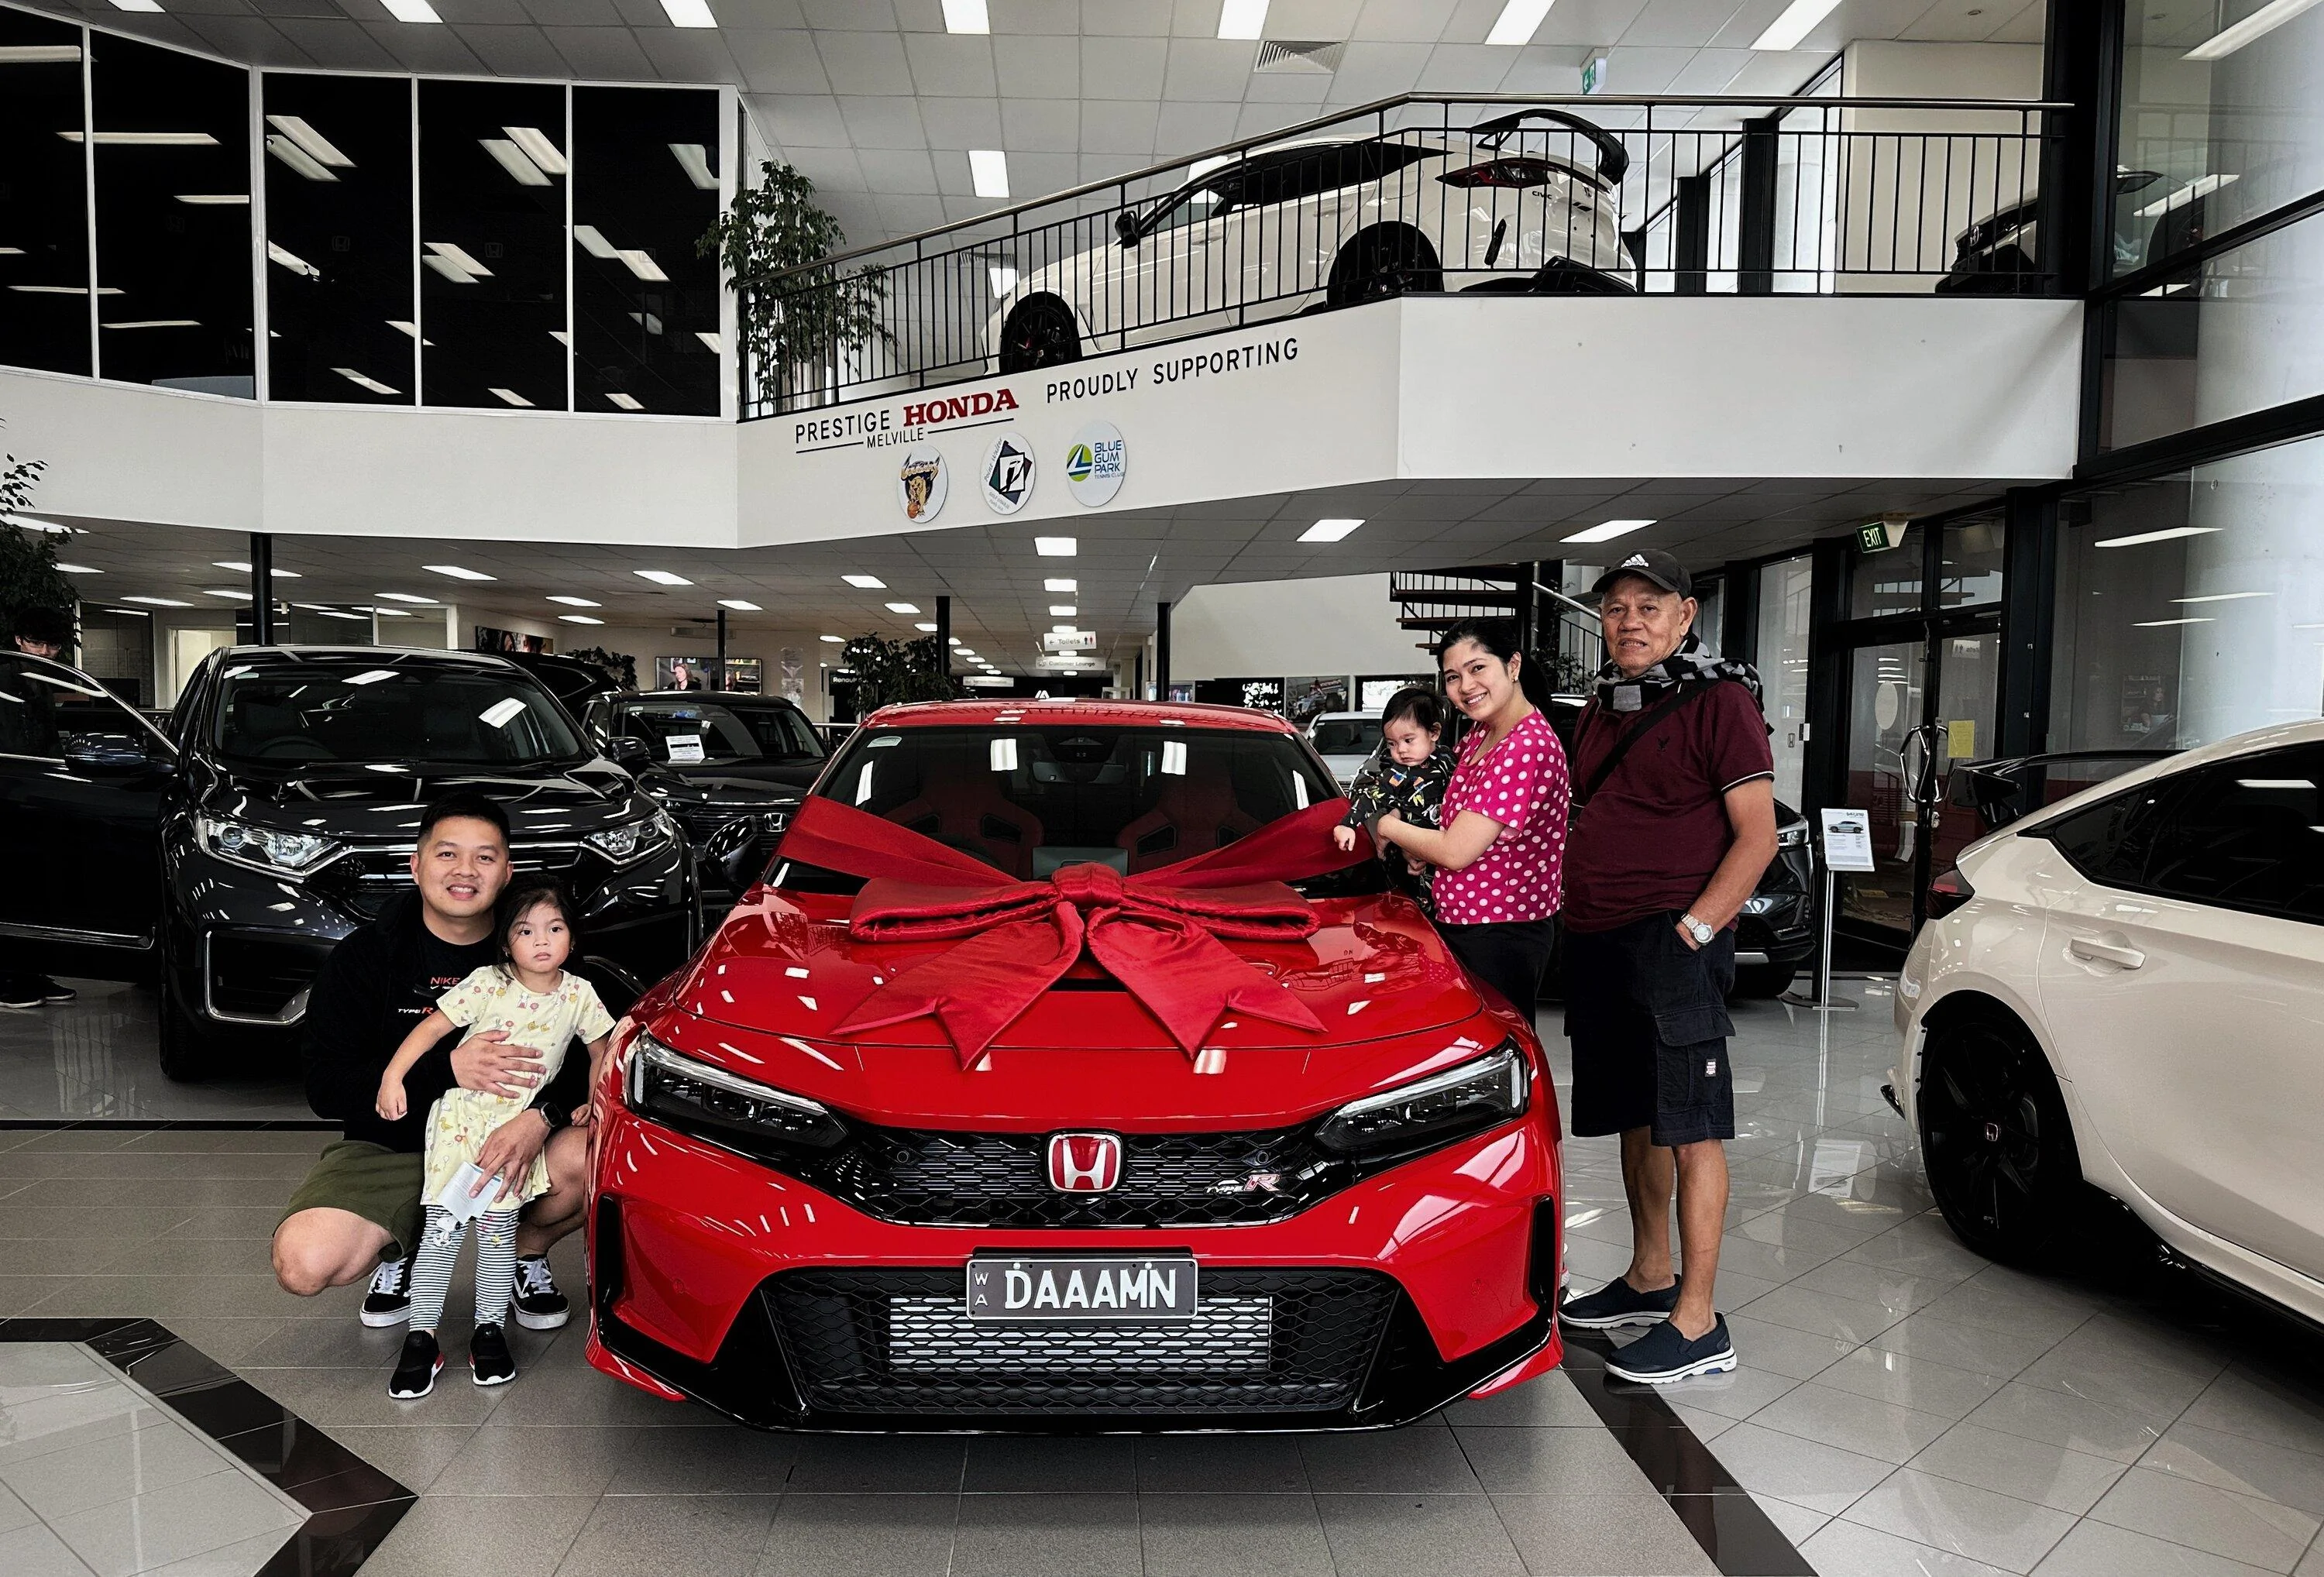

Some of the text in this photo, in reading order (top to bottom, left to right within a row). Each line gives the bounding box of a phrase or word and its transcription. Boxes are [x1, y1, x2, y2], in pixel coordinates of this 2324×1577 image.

[1532, 191, 1552, 200] CIVC
[1047, 338, 1298, 404] PROUDLY SUPPORTING
[796, 388, 1019, 444] PRESTIGE HONDA
[867, 427, 924, 448] MELVILLE
[1095, 440, 1122, 453] BLUE
[1094, 452, 1120, 464] GUM
[1094, 462, 1121, 474] PARK
[1862, 527, 1882, 548] EXIT
[430, 977, 461, 985] NIKE
[1004, 1269, 1177, 1310] DAAAMN
